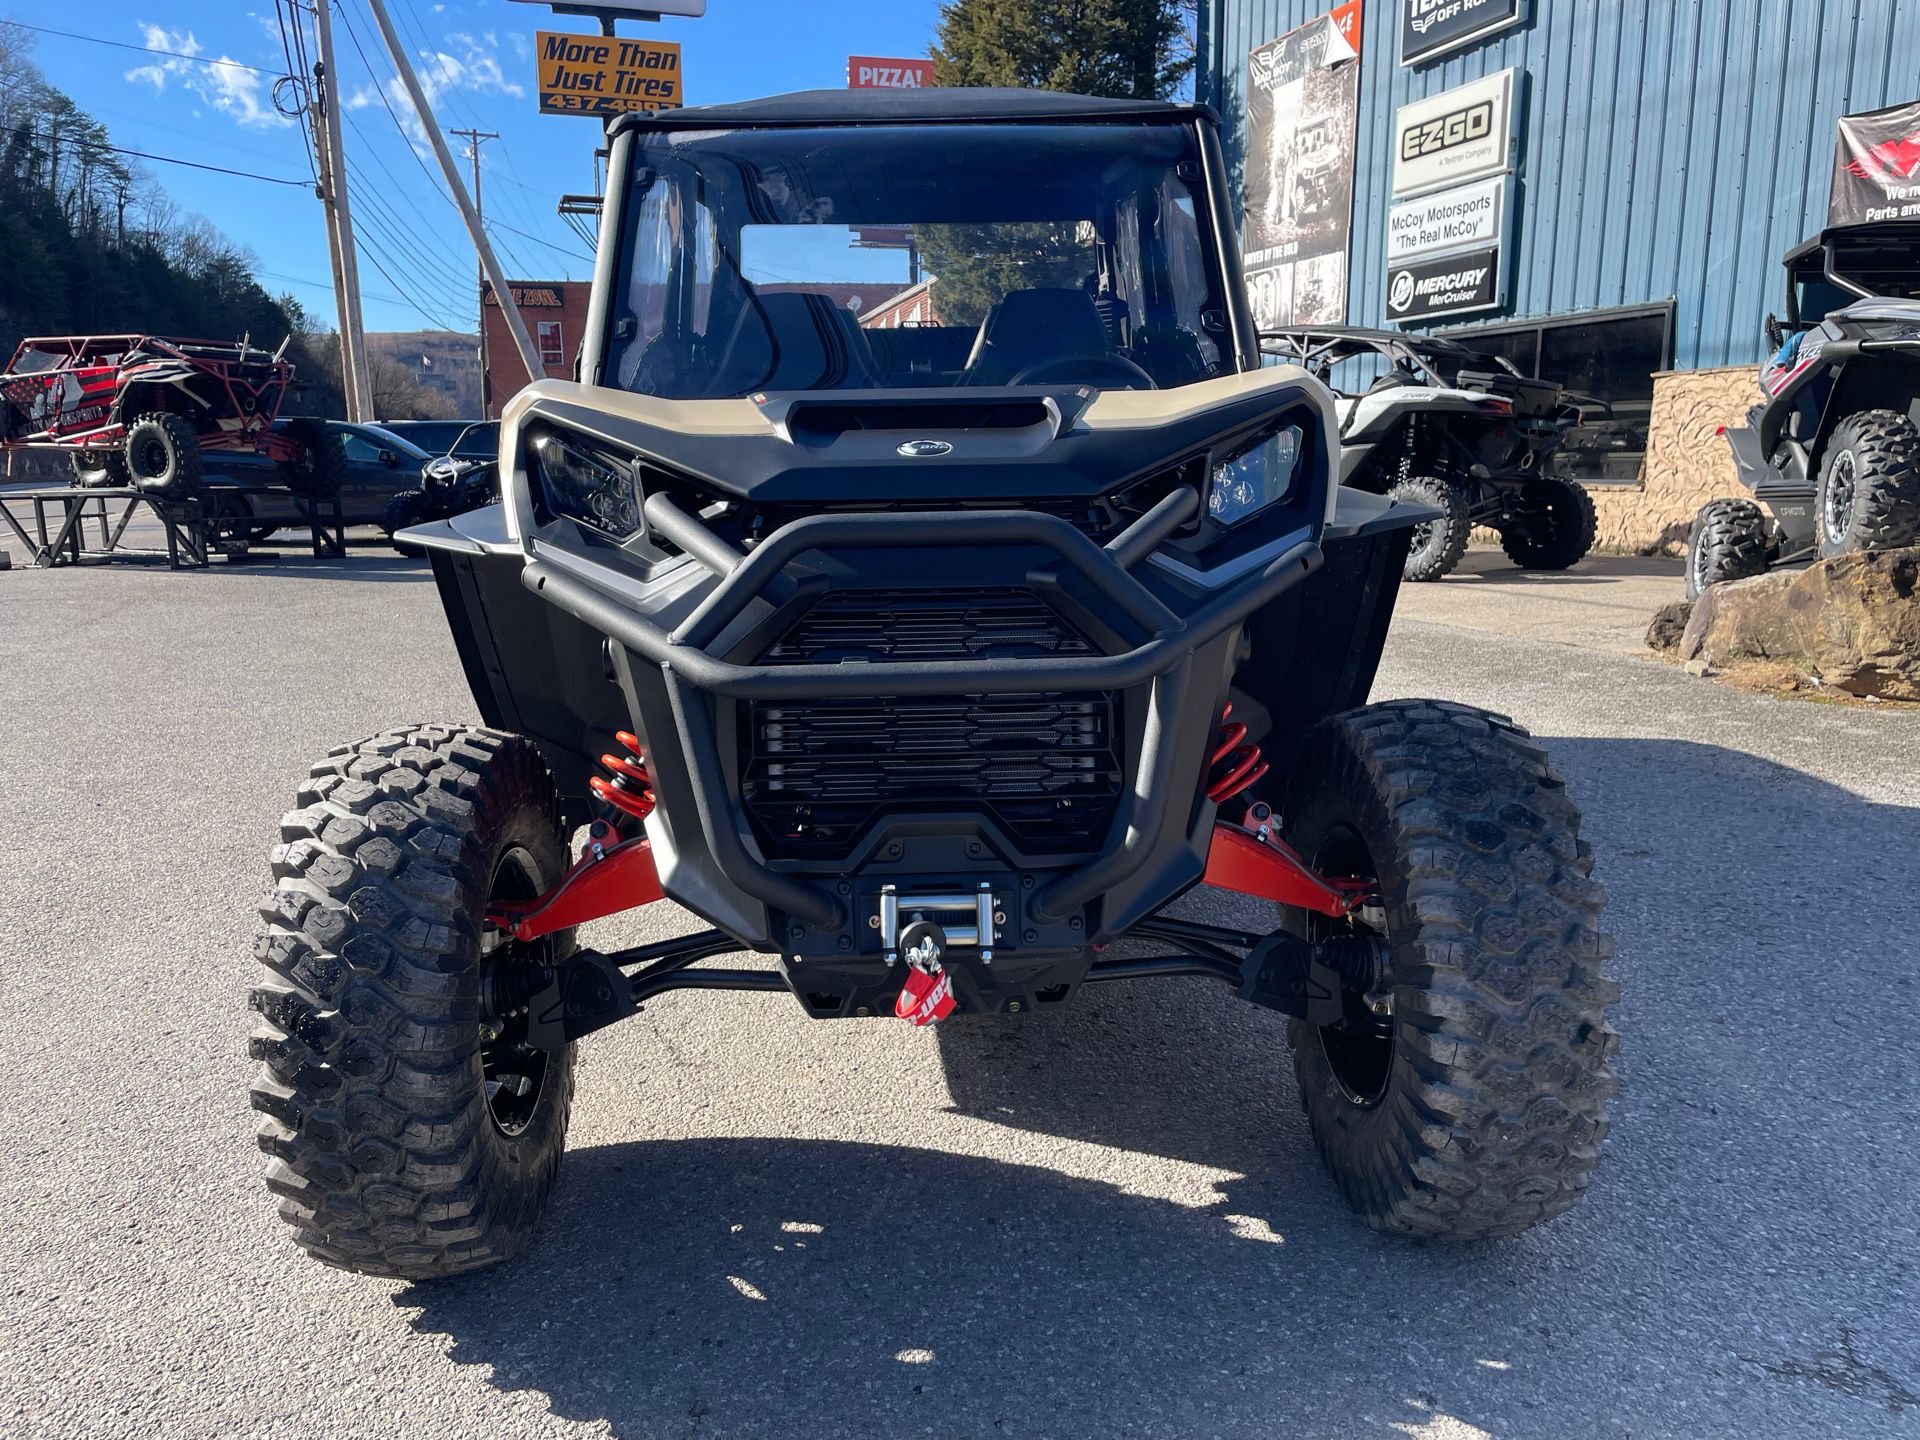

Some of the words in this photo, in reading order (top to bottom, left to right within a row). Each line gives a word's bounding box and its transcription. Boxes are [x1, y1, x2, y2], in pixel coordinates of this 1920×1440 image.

[1436, 1, 1461, 22] OFF
[543, 36, 609, 64] More
[618, 43, 677, 70] Than
[858, 66, 923, 89] PIZZA!
[1272, 60, 1293, 77] BOY
[547, 65, 607, 92] Just
[614, 70, 675, 97] Tires
[1403, 104, 1489, 160] EZGO
[1465, 147, 1492, 161] Company
[1886, 186, 1907, 201] We
[1392, 213, 1424, 231] McCoy
[1427, 195, 1491, 222] Motorsports
[1865, 206, 1898, 222] Parts
[1419, 226, 1441, 245] Real
[1415, 266, 1488, 296] MERCURY
[523, 288, 562, 306] ZONE
[1428, 290, 1477, 306] MerCruiser
